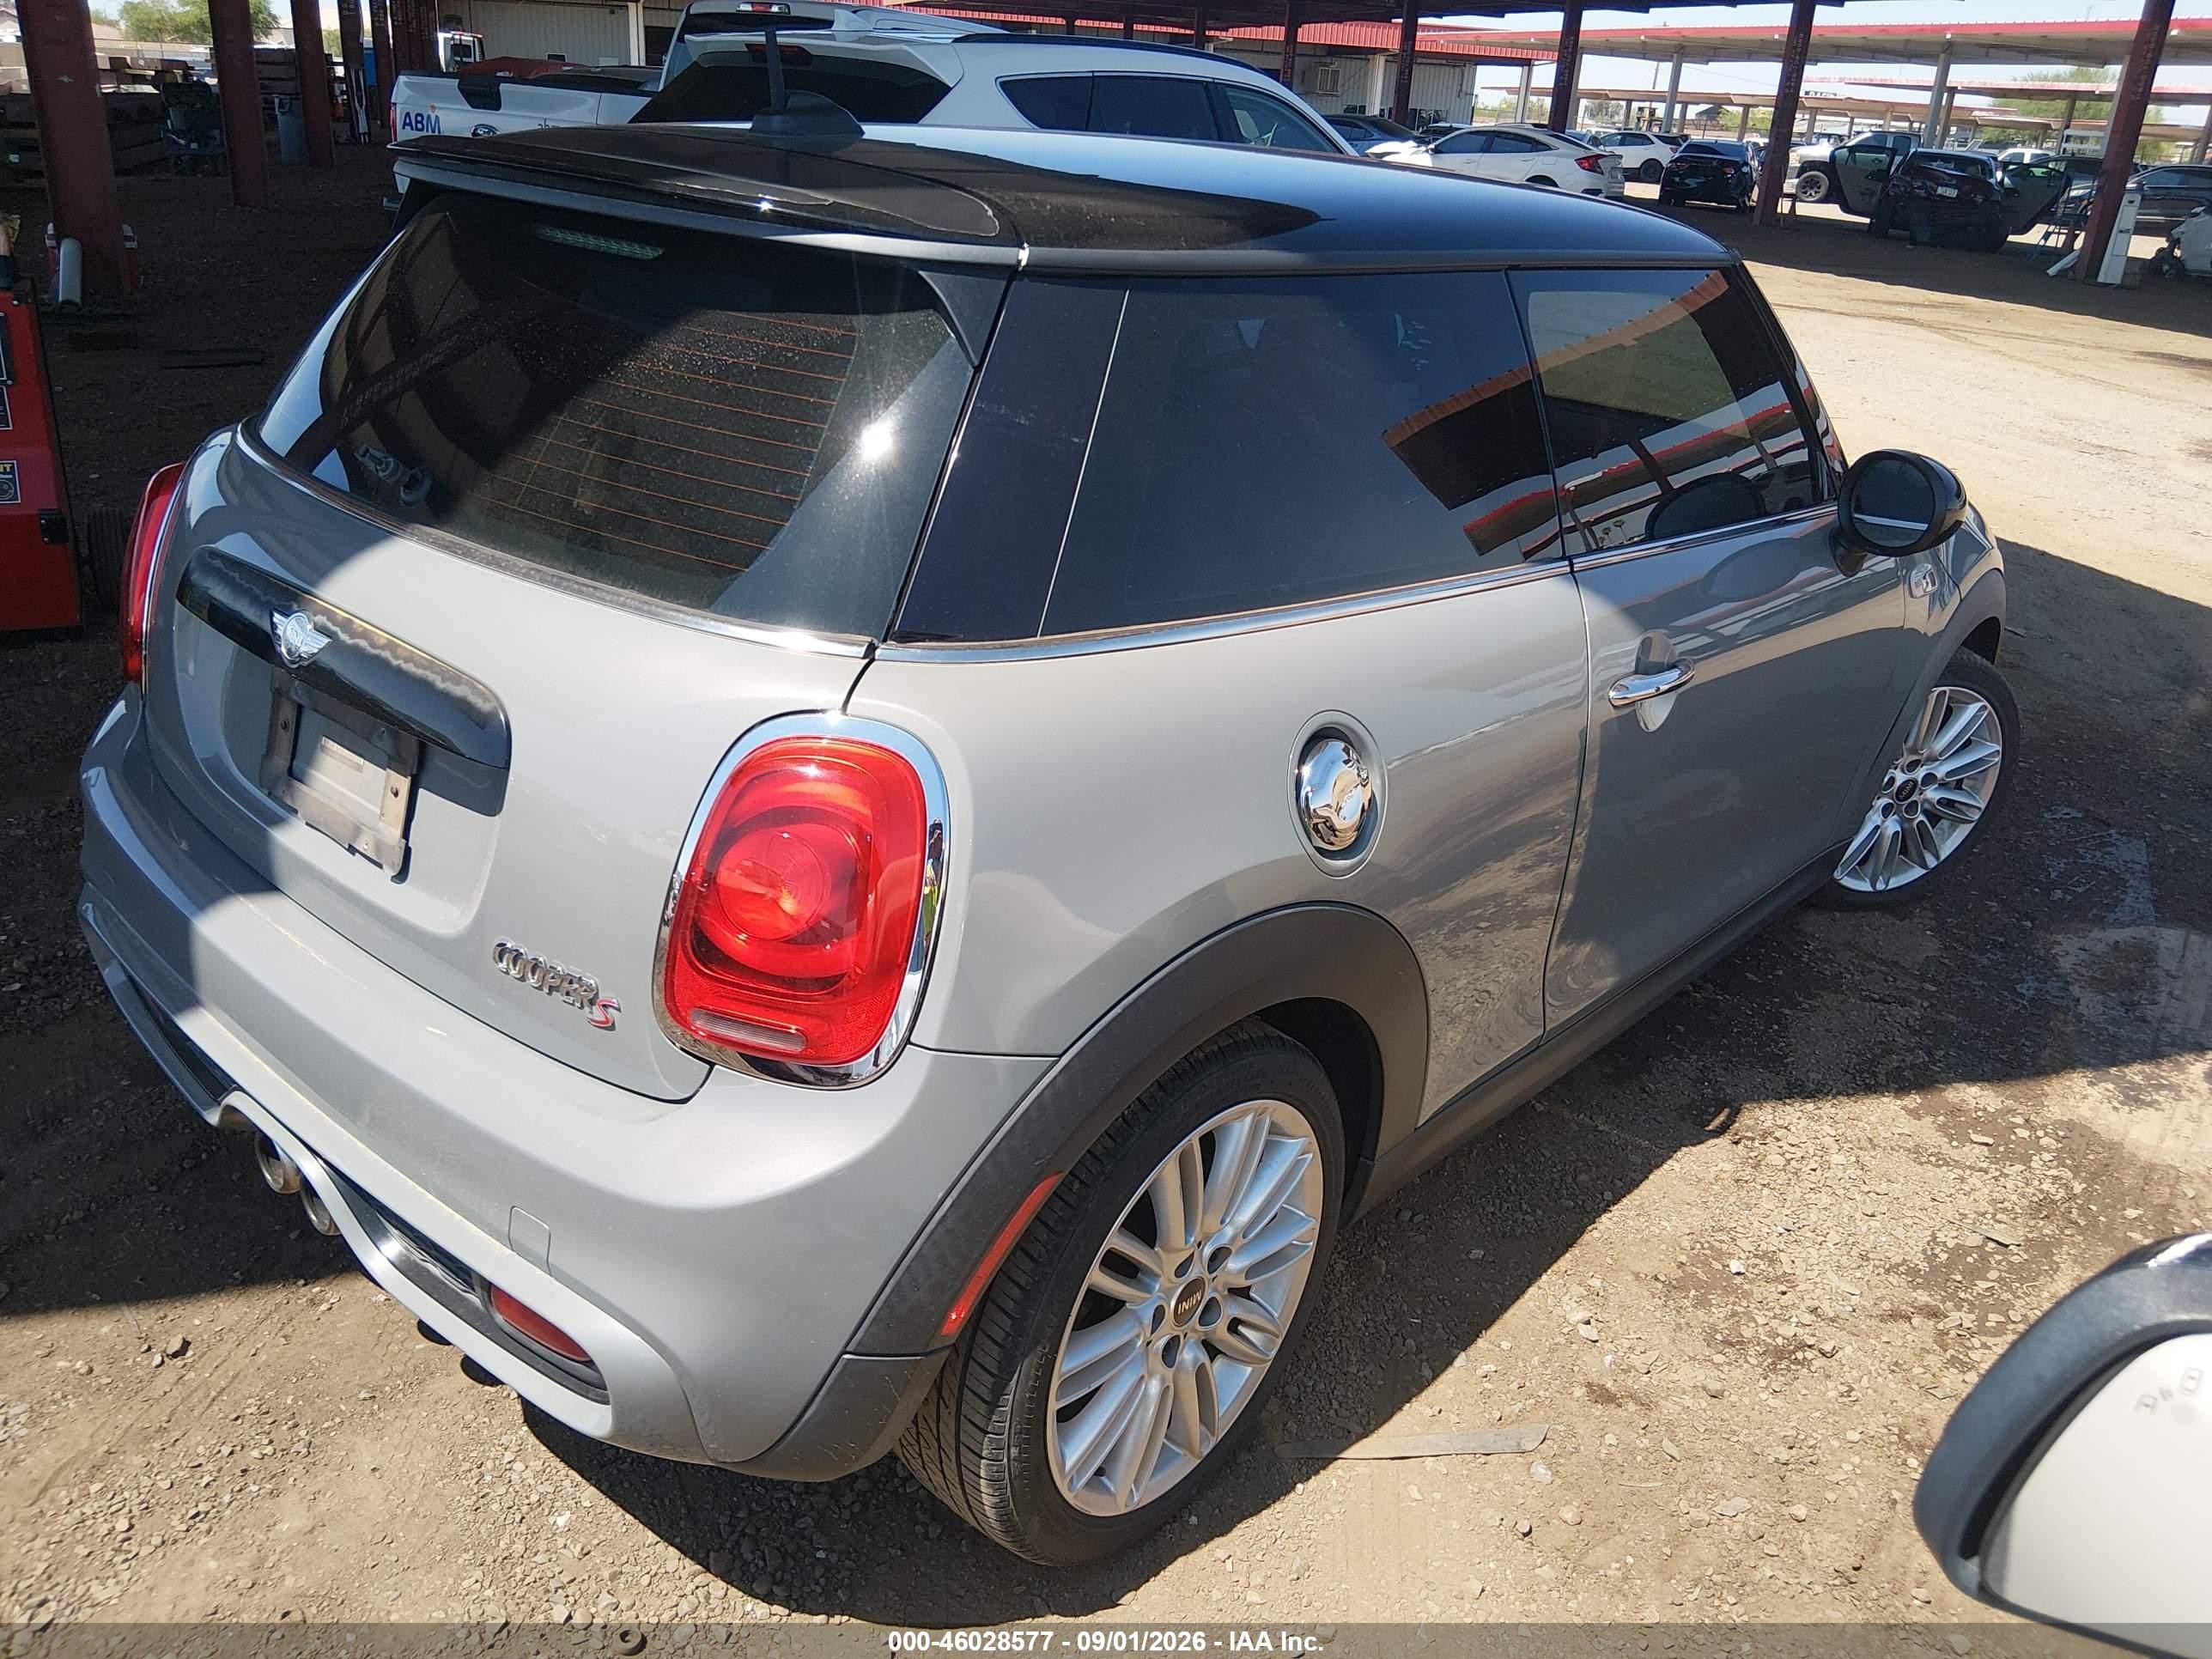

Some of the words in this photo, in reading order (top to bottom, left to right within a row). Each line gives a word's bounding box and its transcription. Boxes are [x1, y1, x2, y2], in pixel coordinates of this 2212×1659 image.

[402, 112, 441, 134] ABM
[1899, 781, 1915, 798] MINI
[492, 937, 599, 1013] COOPER
[586, 997, 622, 1032] S
[1177, 1289, 1202, 1315] MINI
